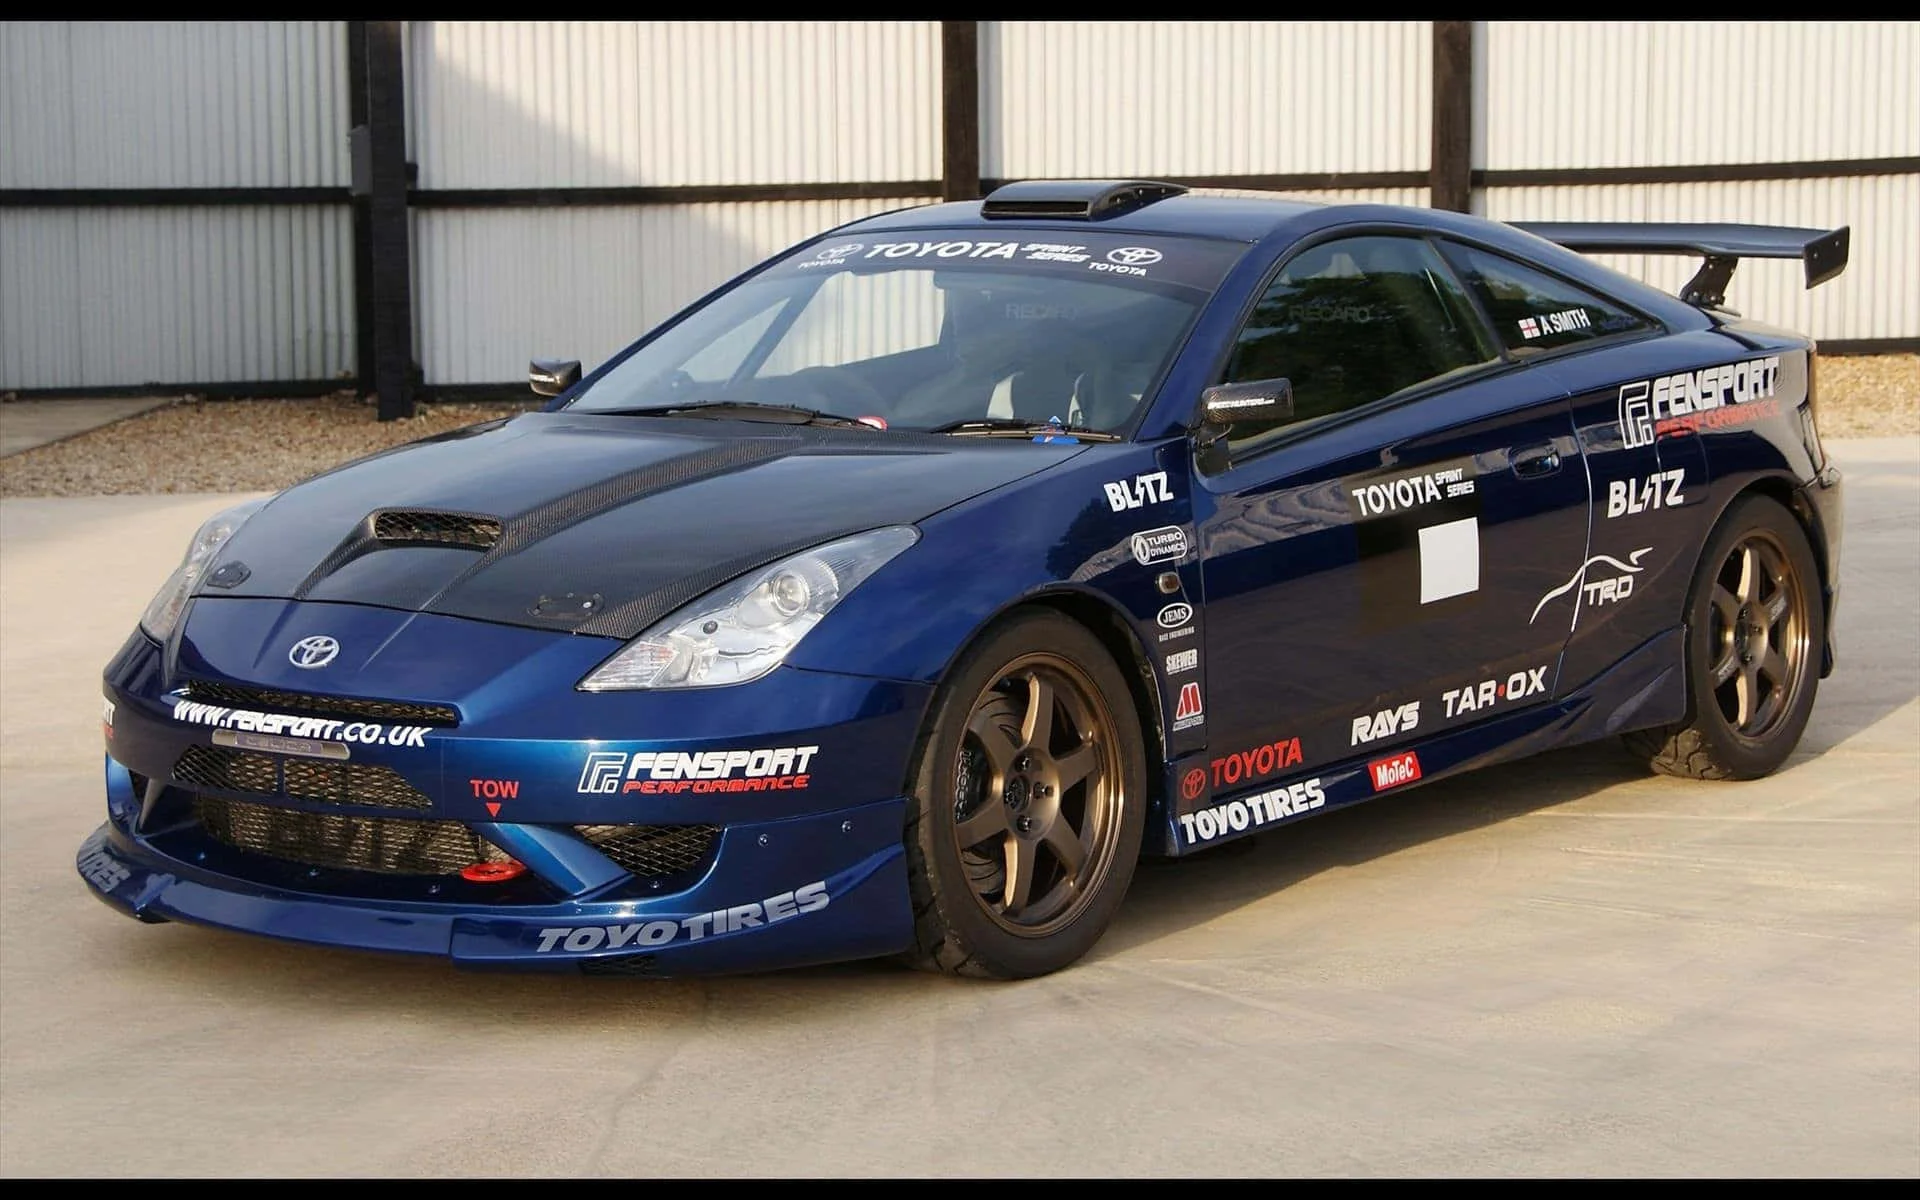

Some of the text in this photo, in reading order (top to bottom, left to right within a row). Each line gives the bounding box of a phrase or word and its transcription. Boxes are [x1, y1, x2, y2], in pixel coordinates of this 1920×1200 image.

[864, 241, 1019, 259] TOYOTA
[1021, 243, 1087, 254] SPRINT
[1026, 252, 1091, 262] SERIES
[1088, 262, 1147, 277] TOYOTA
[1540, 308, 1592, 335] A SMITH
[1653, 357, 1779, 420] FENSPORT
[1103, 471, 1175, 512] BLITZ
[1352, 468, 1463, 516] TOYOTA SPRINT
[1447, 480, 1475, 498] SERIES
[1606, 468, 1685, 519] BLITZ
[1147, 531, 1183, 545] TURBO
[1150, 542, 1185, 557] DYNAMICS
[1583, 575, 1634, 607] TRD
[1162, 607, 1187, 624] JEMS
[1166, 649, 1198, 673] SKEWER
[172, 700, 433, 748] WWW.FENSPORT.CO.UK
[1351, 701, 1420, 747] RAYS
[627, 746, 819, 780] FENSPORT
[1211, 736, 1304, 788] TOYOTA
[1376, 758, 1415, 788] MoTeC
[470, 779, 520, 799] TOW
[622, 774, 811, 795] PERFORMANCE
